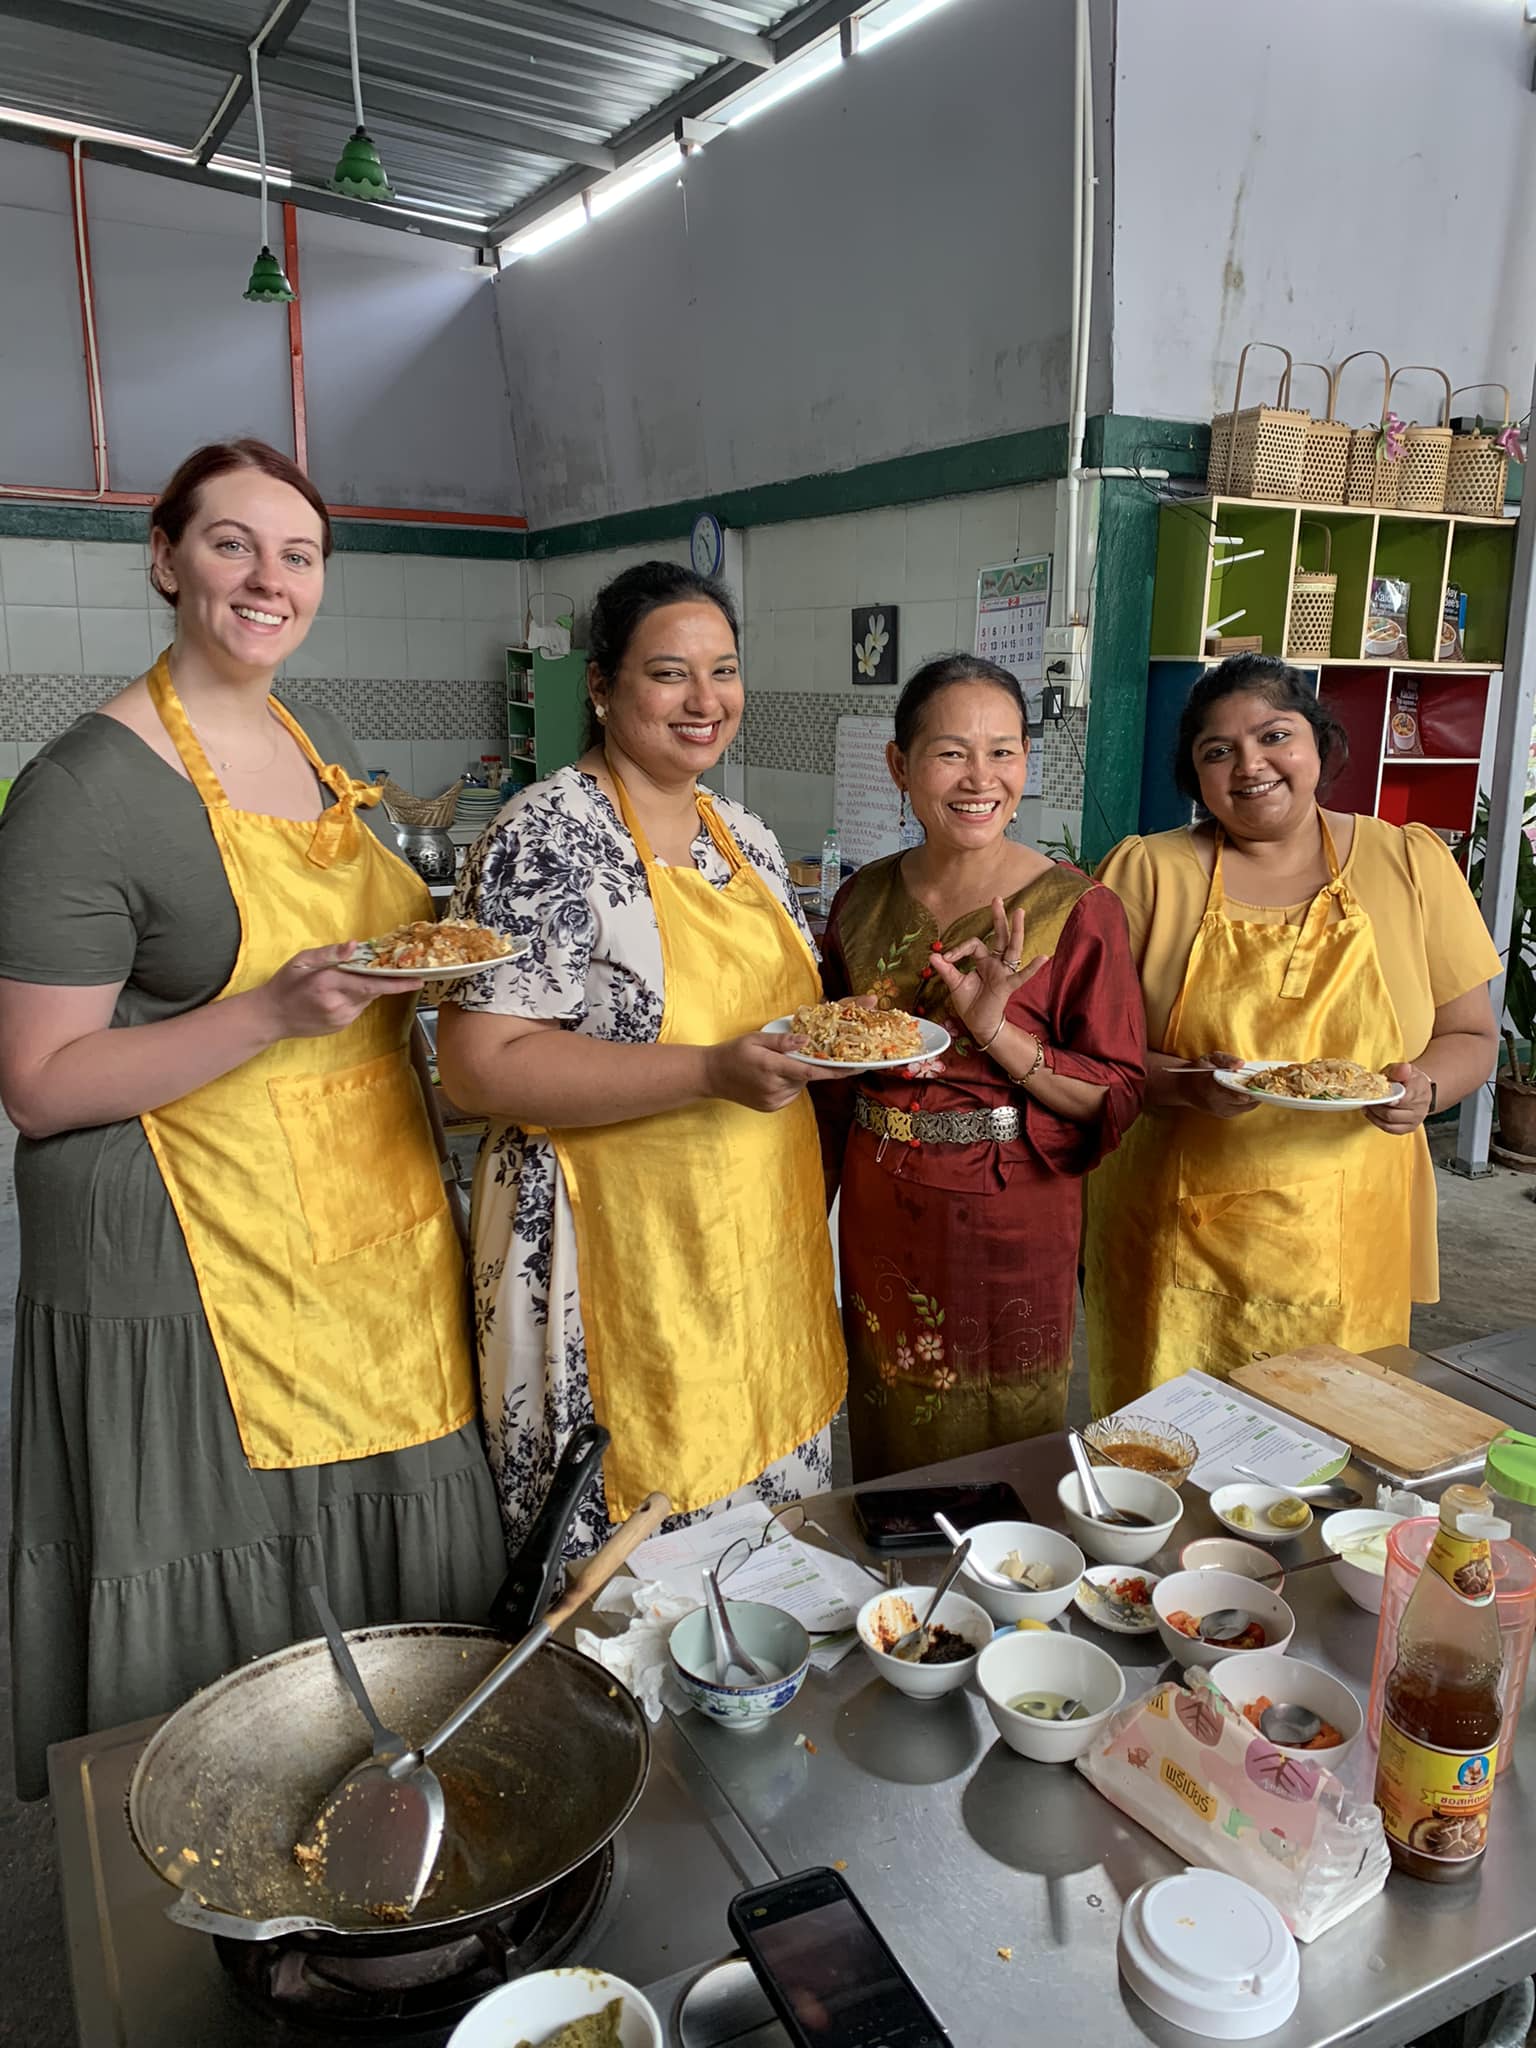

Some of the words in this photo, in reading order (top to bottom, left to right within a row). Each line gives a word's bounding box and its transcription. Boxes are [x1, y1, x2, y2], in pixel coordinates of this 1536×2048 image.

[1027, 622, 1033, 631] 10
[980, 642, 987, 651] 12
[991, 641, 998, 650] 13
[1001, 640, 1007, 649] 14
[1010, 639, 1016, 648] 15
[1027, 636, 1033, 646] 17
[1000, 655, 1006, 664] 21
[1009, 654, 1015, 663] 22
[1018, 652, 1024, 661] 23
[1027, 651, 1033, 660] 24
